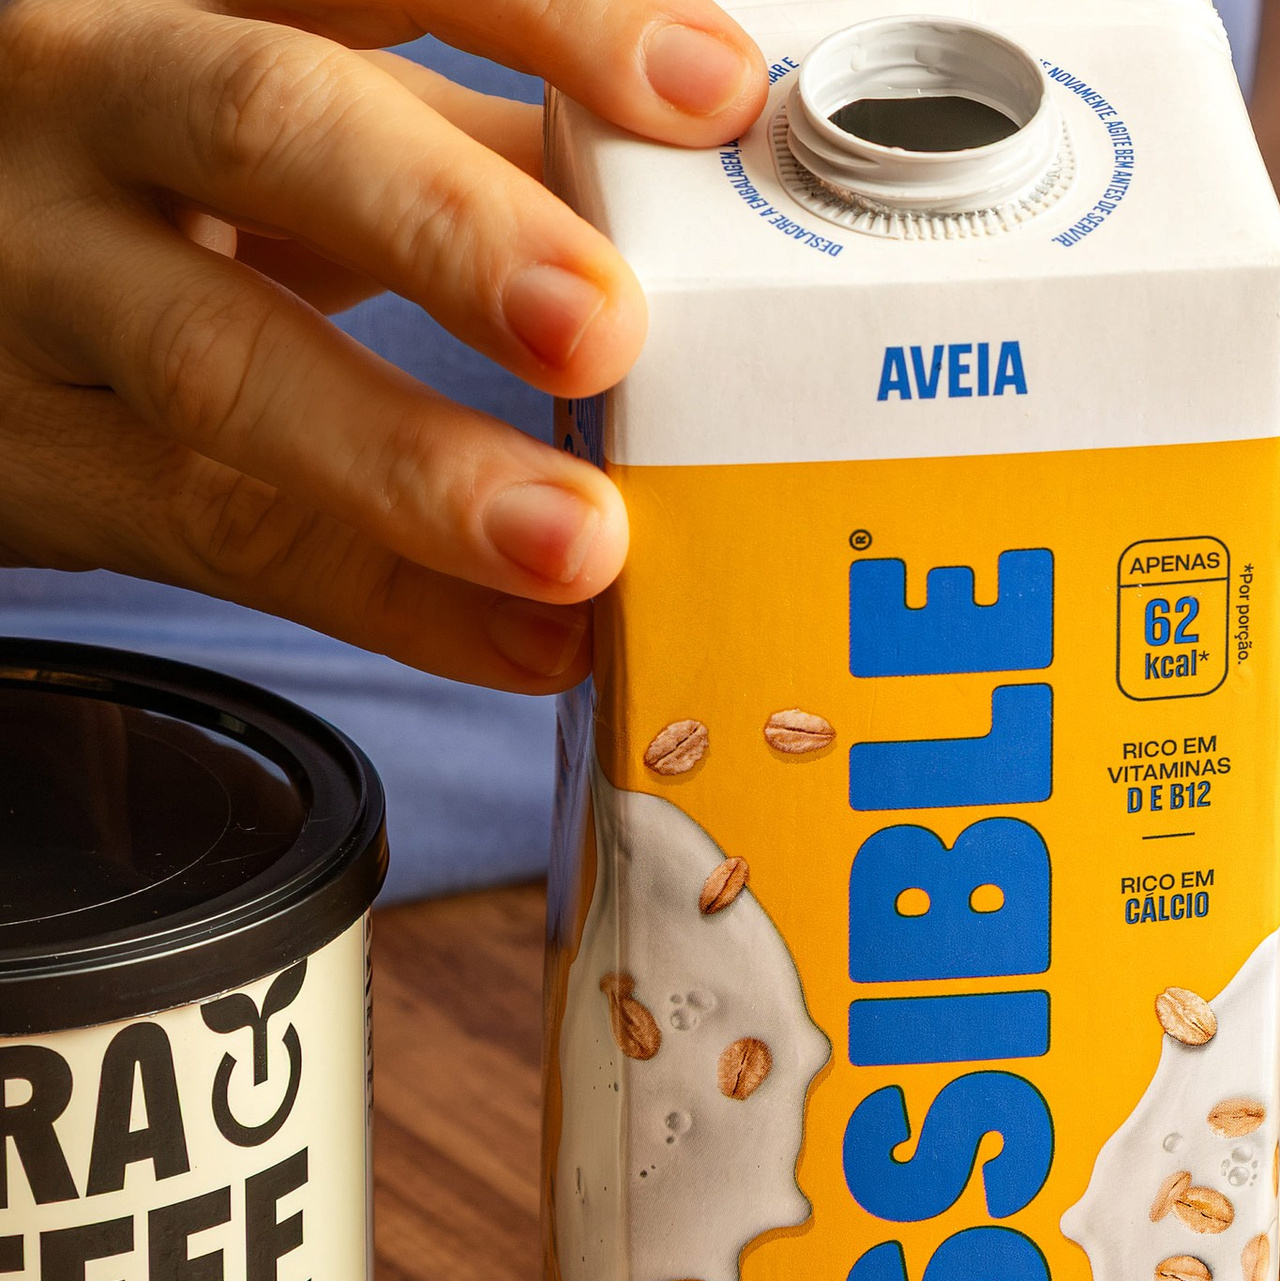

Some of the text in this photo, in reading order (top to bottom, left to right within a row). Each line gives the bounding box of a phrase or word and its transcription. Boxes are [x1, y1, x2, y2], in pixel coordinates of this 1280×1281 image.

[1047, 66, 1135, 247] NOVAMENTE AGITE BEM ANTES DE SERVIR.
[719, 149, 844, 257] DESLACRE A EMBALAGEM,
[876, 340, 1029, 402] AVEIA
[1129, 551, 1220, 575] APENAS
[1144, 595, 1200, 648] 62
[1234, 605, 1253, 665] porção.
[1107, 756, 1231, 784] VITAMINAS
[1122, 735, 1217, 761] RICO EM
[1127, 780, 1212, 814] D E B12
[1120, 868, 1215, 895] RICO EM
[1124, 890, 1210, 925] CÁLCIO
[0, 1021, 191, 1209] RA
